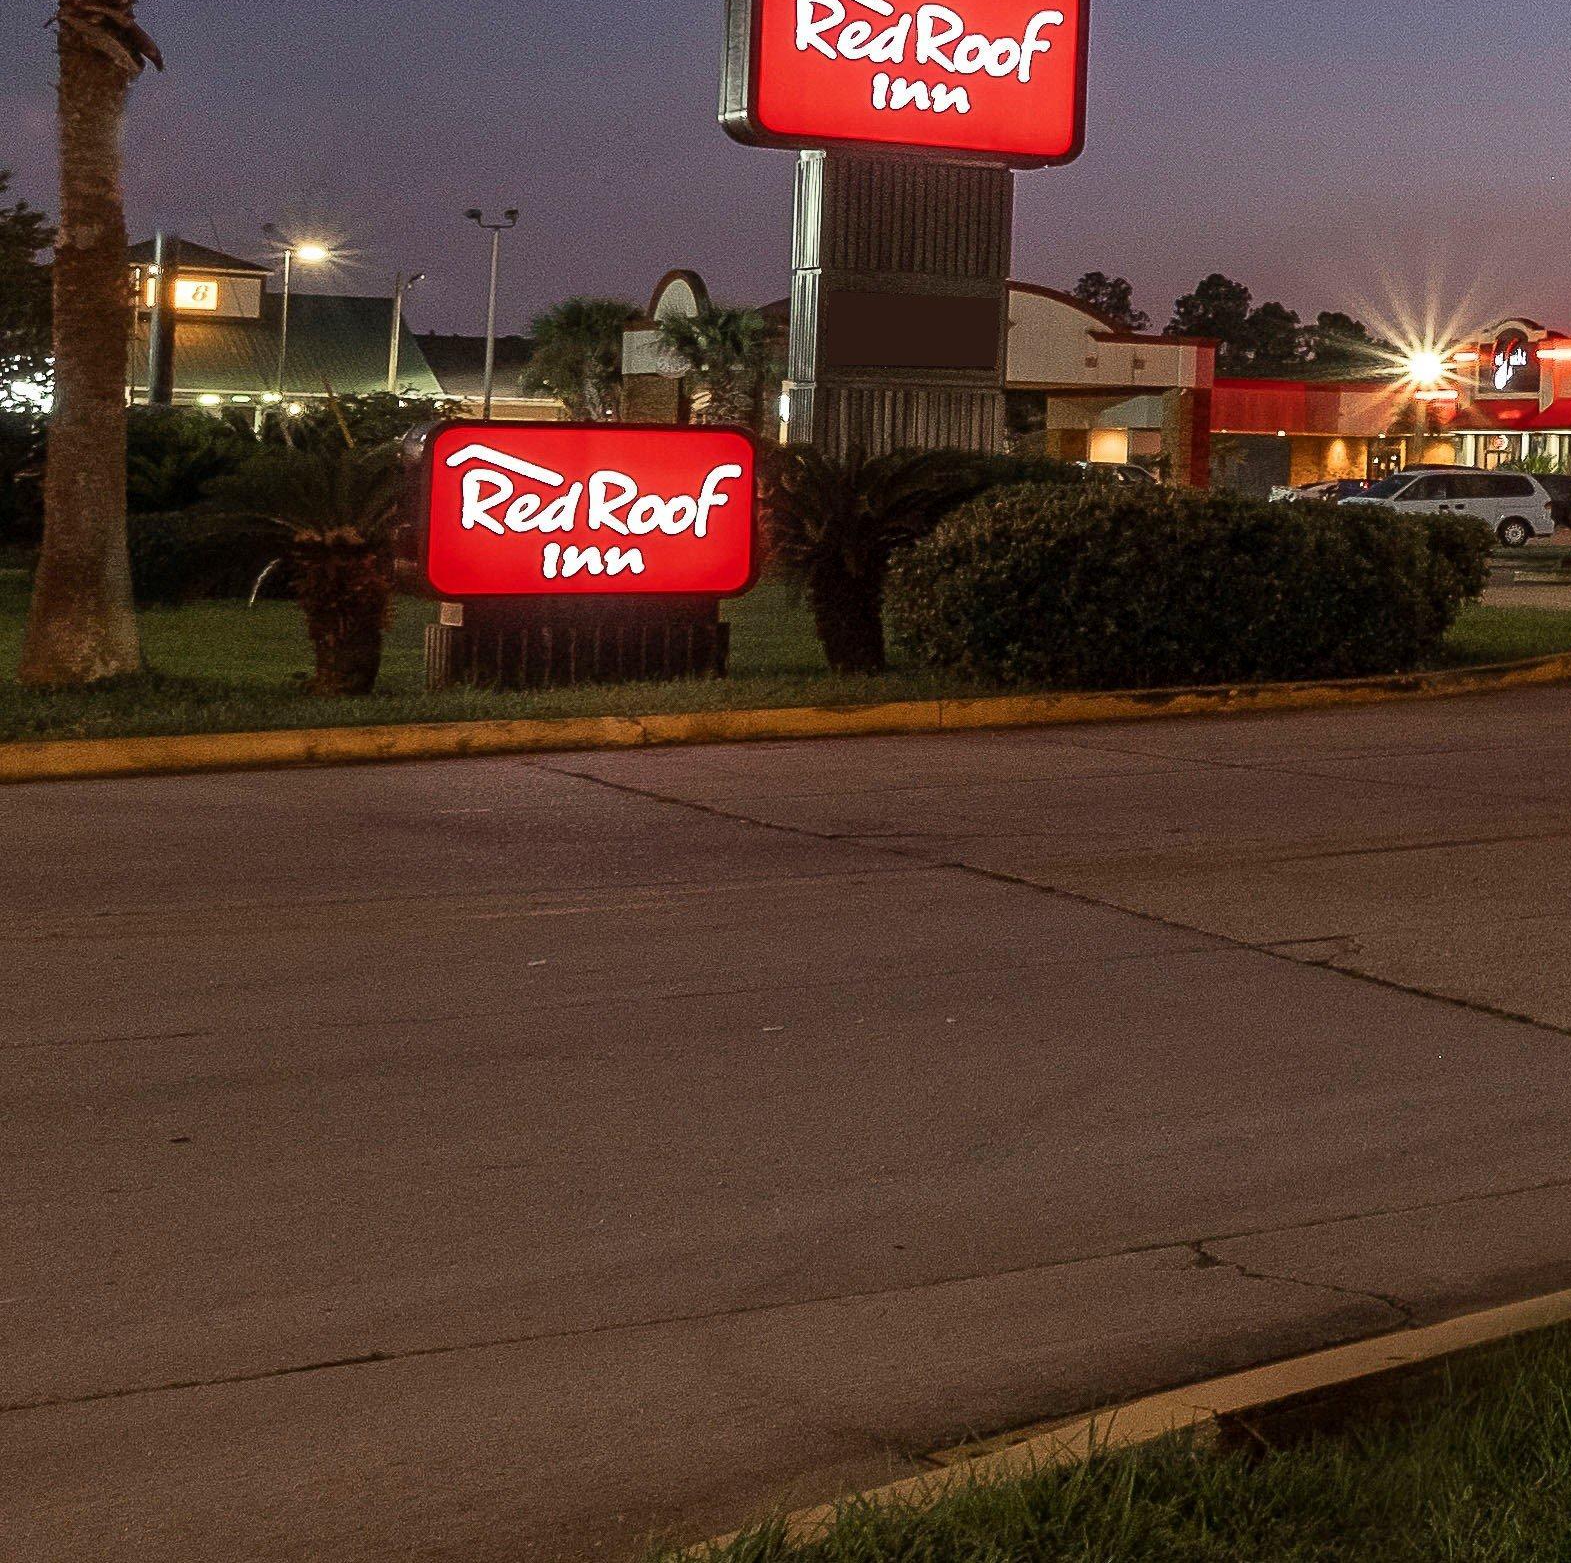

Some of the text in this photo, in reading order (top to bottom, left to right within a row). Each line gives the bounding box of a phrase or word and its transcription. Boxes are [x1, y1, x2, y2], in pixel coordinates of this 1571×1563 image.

[916, 3, 1064, 83] Roof
[462, 464, 742, 537] Red Roof
